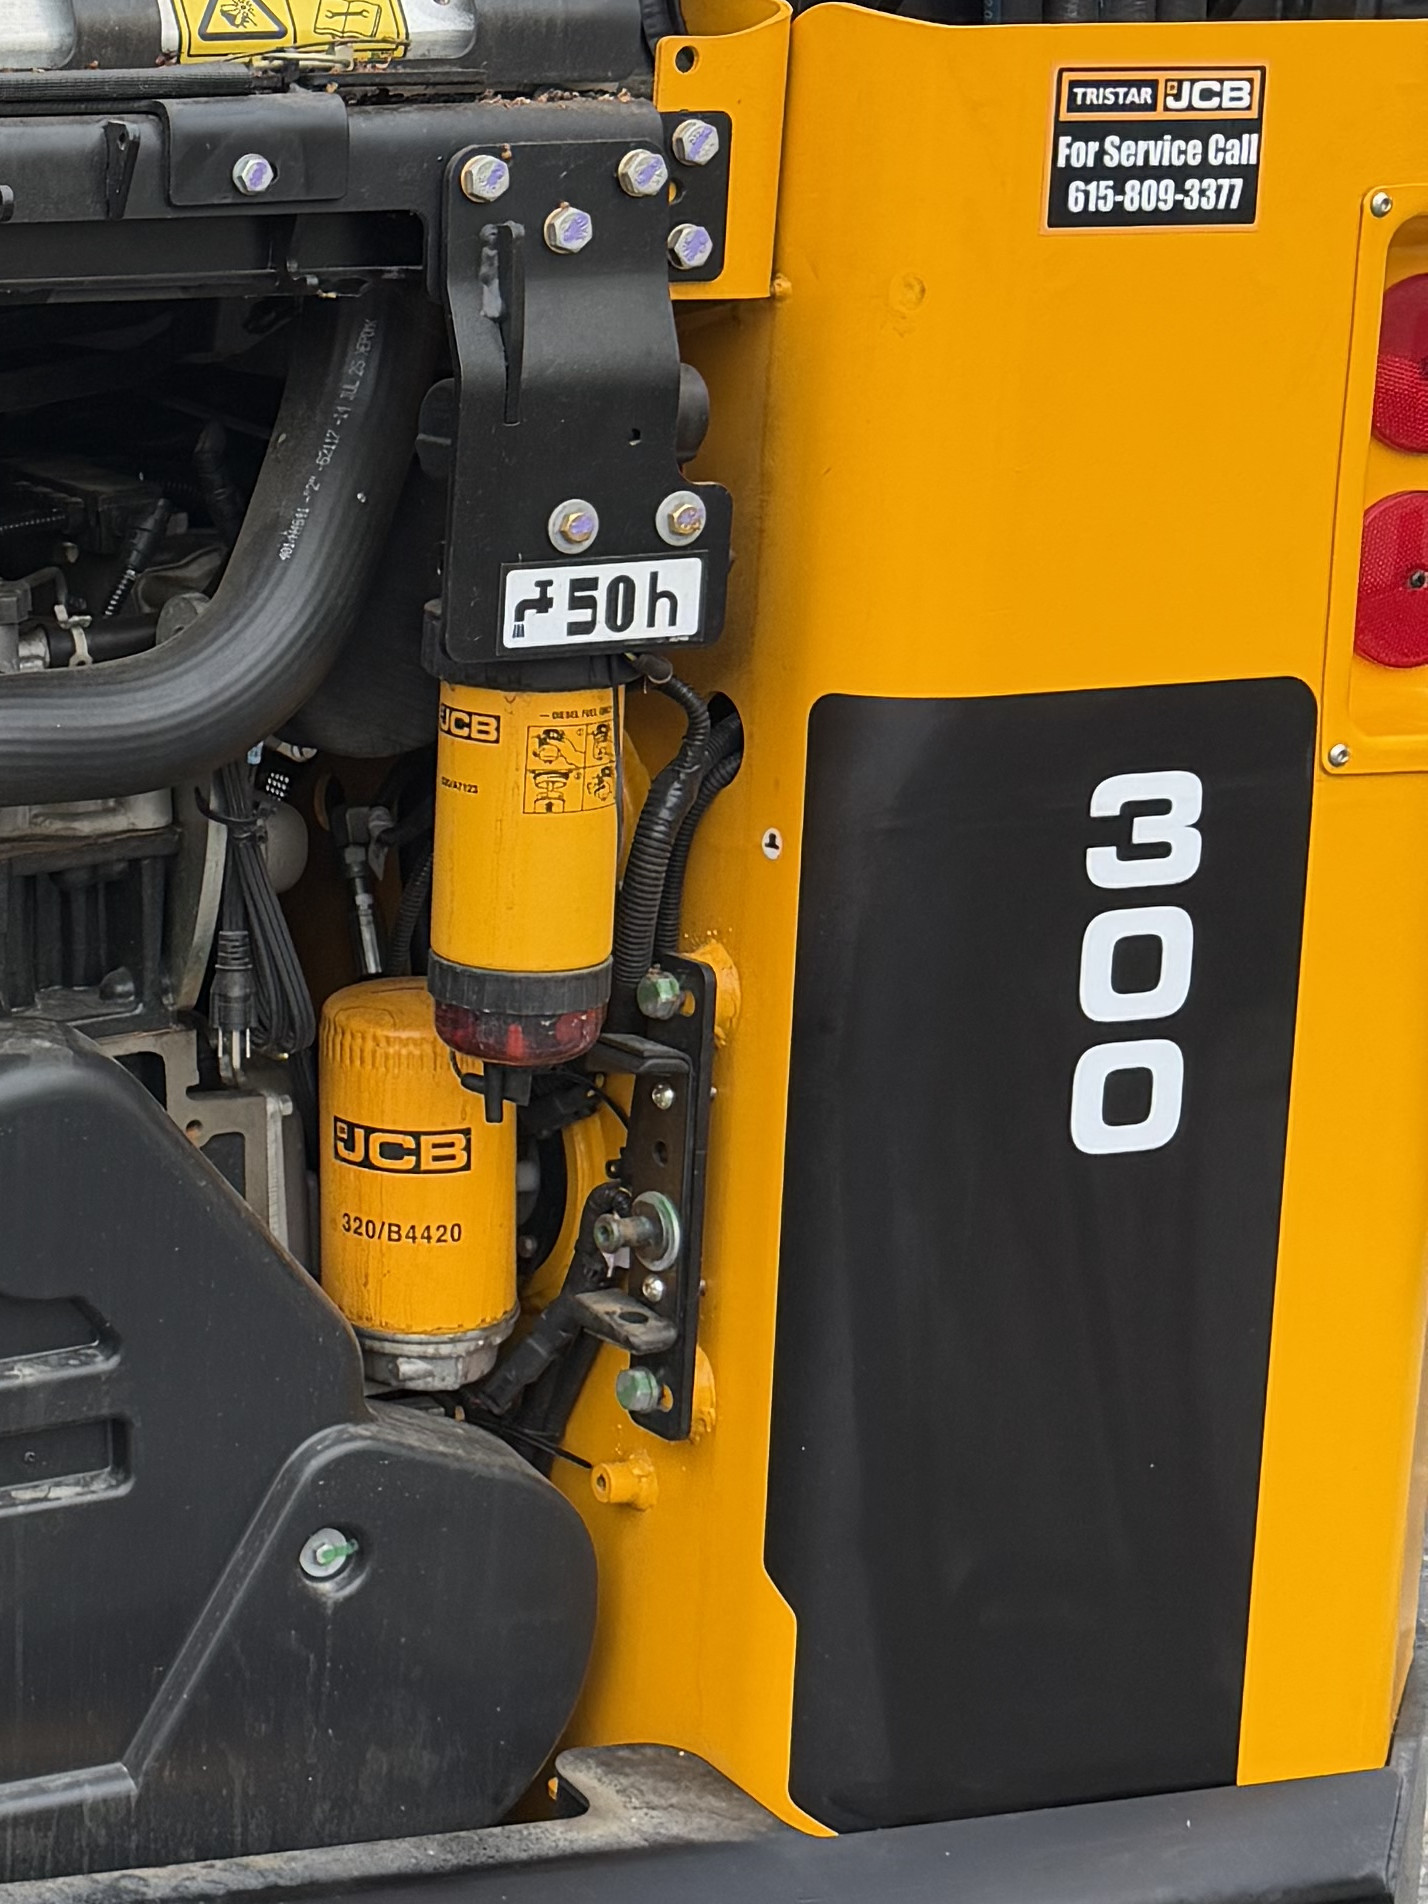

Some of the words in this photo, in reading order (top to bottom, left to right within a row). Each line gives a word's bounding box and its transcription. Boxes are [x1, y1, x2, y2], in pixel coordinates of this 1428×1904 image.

[1072, 87, 1153, 106] TRISTAR
[1165, 80, 1252, 110] JCB
[1056, 135, 1100, 168] For
[1102, 134, 1202, 168] Service
[1207, 133, 1260, 166] Call
[1067, 177, 1244, 213] 615-809-3377
[440, 707, 498, 743] JCB
[1070, 770, 1203, 1155] 300
[336, 1122, 467, 1171] JCB
[342, 1212, 462, 1244] 320/B4420
